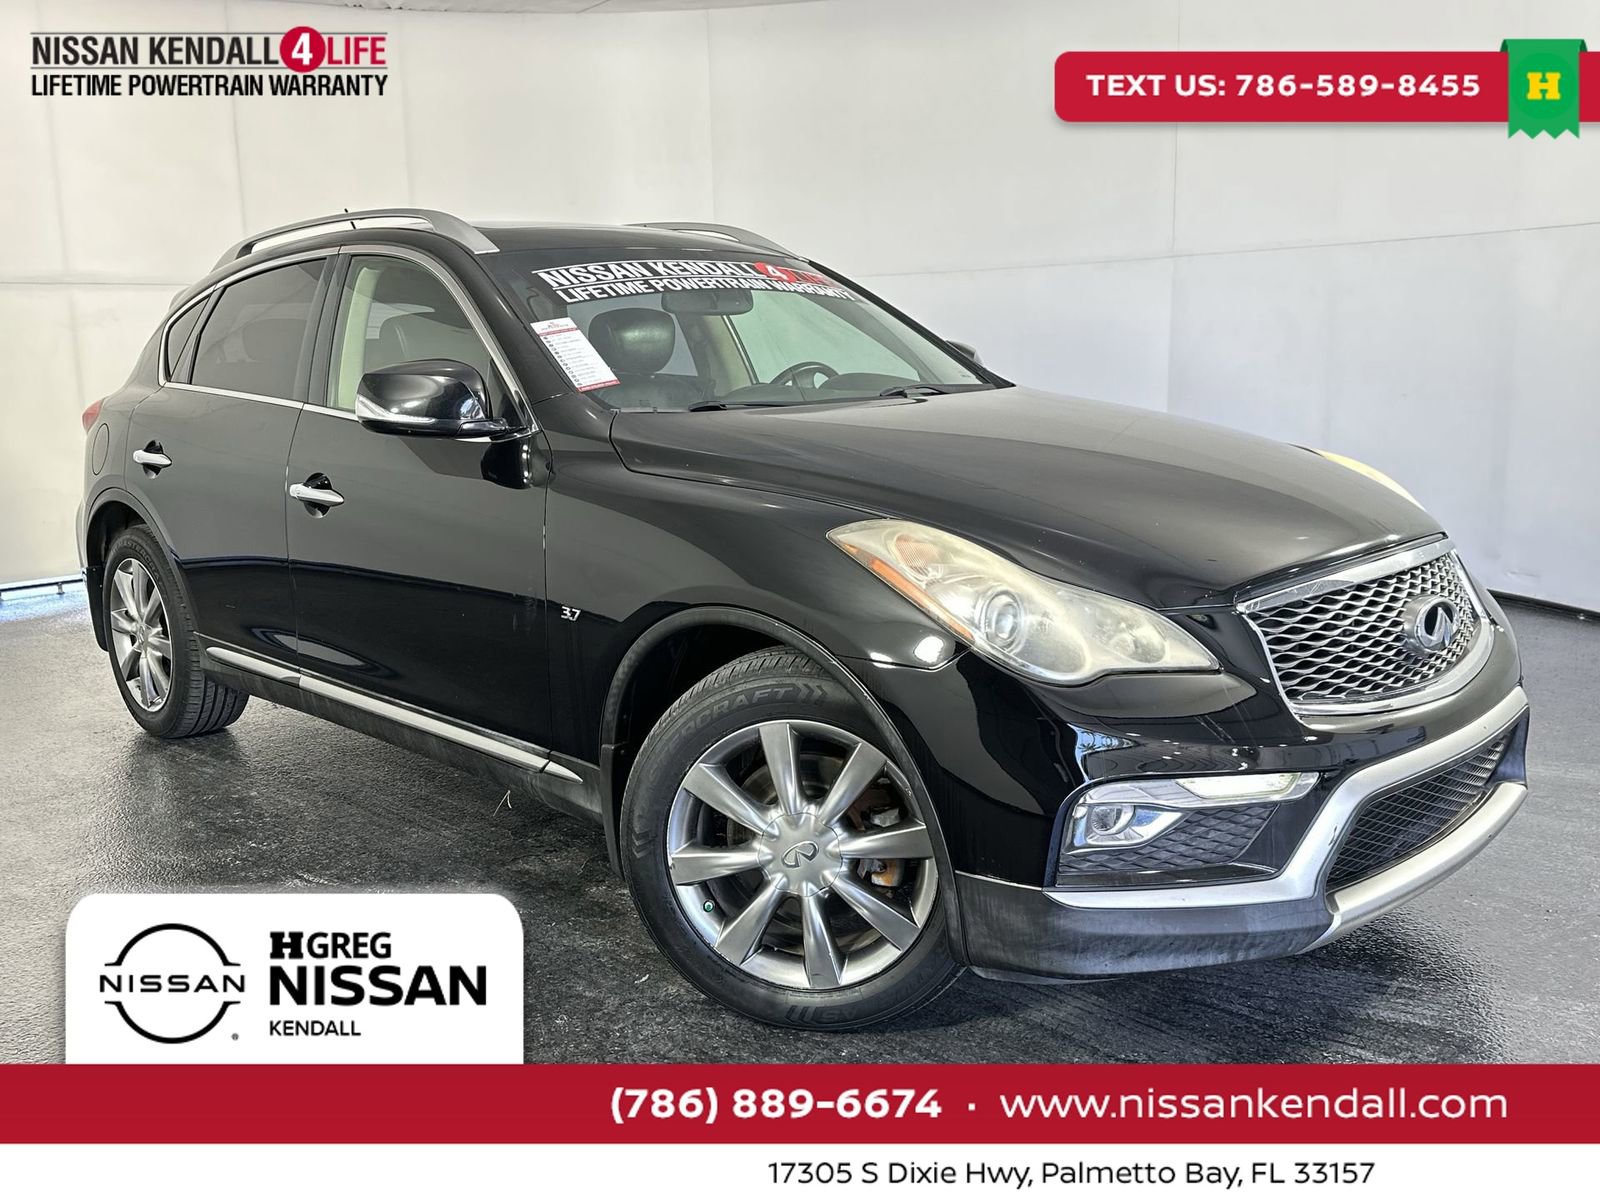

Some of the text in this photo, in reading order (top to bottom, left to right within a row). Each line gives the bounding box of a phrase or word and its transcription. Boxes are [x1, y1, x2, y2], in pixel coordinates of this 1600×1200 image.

[537, 261, 653, 288] NISSAN
[647, 261, 767, 278] KENDALL
[555, 277, 856, 303] LIFETIME POWERTRAIN WARRANTY
